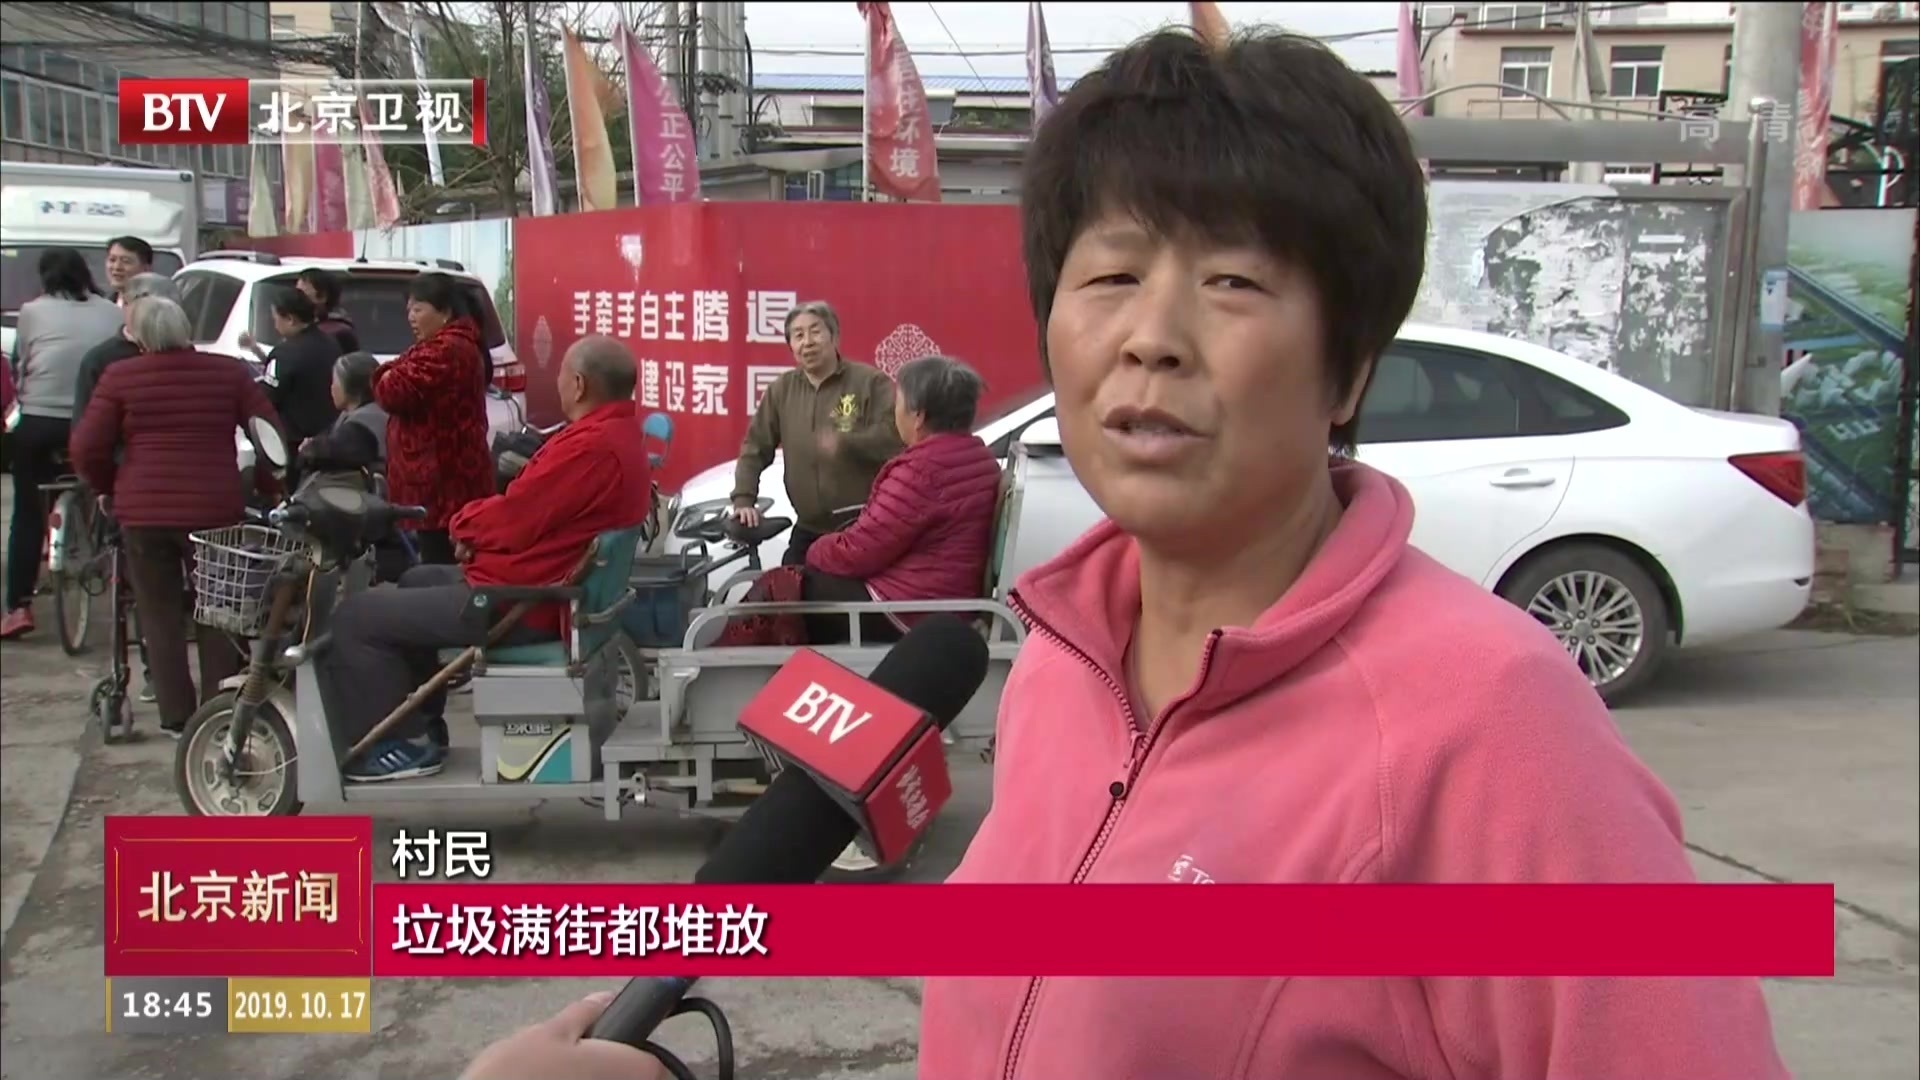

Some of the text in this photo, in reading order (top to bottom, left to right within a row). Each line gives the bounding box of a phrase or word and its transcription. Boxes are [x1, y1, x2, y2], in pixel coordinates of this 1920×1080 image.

[574, 290, 797, 343] 手牵手自主腾退
[783, 681, 872, 744] BTV
